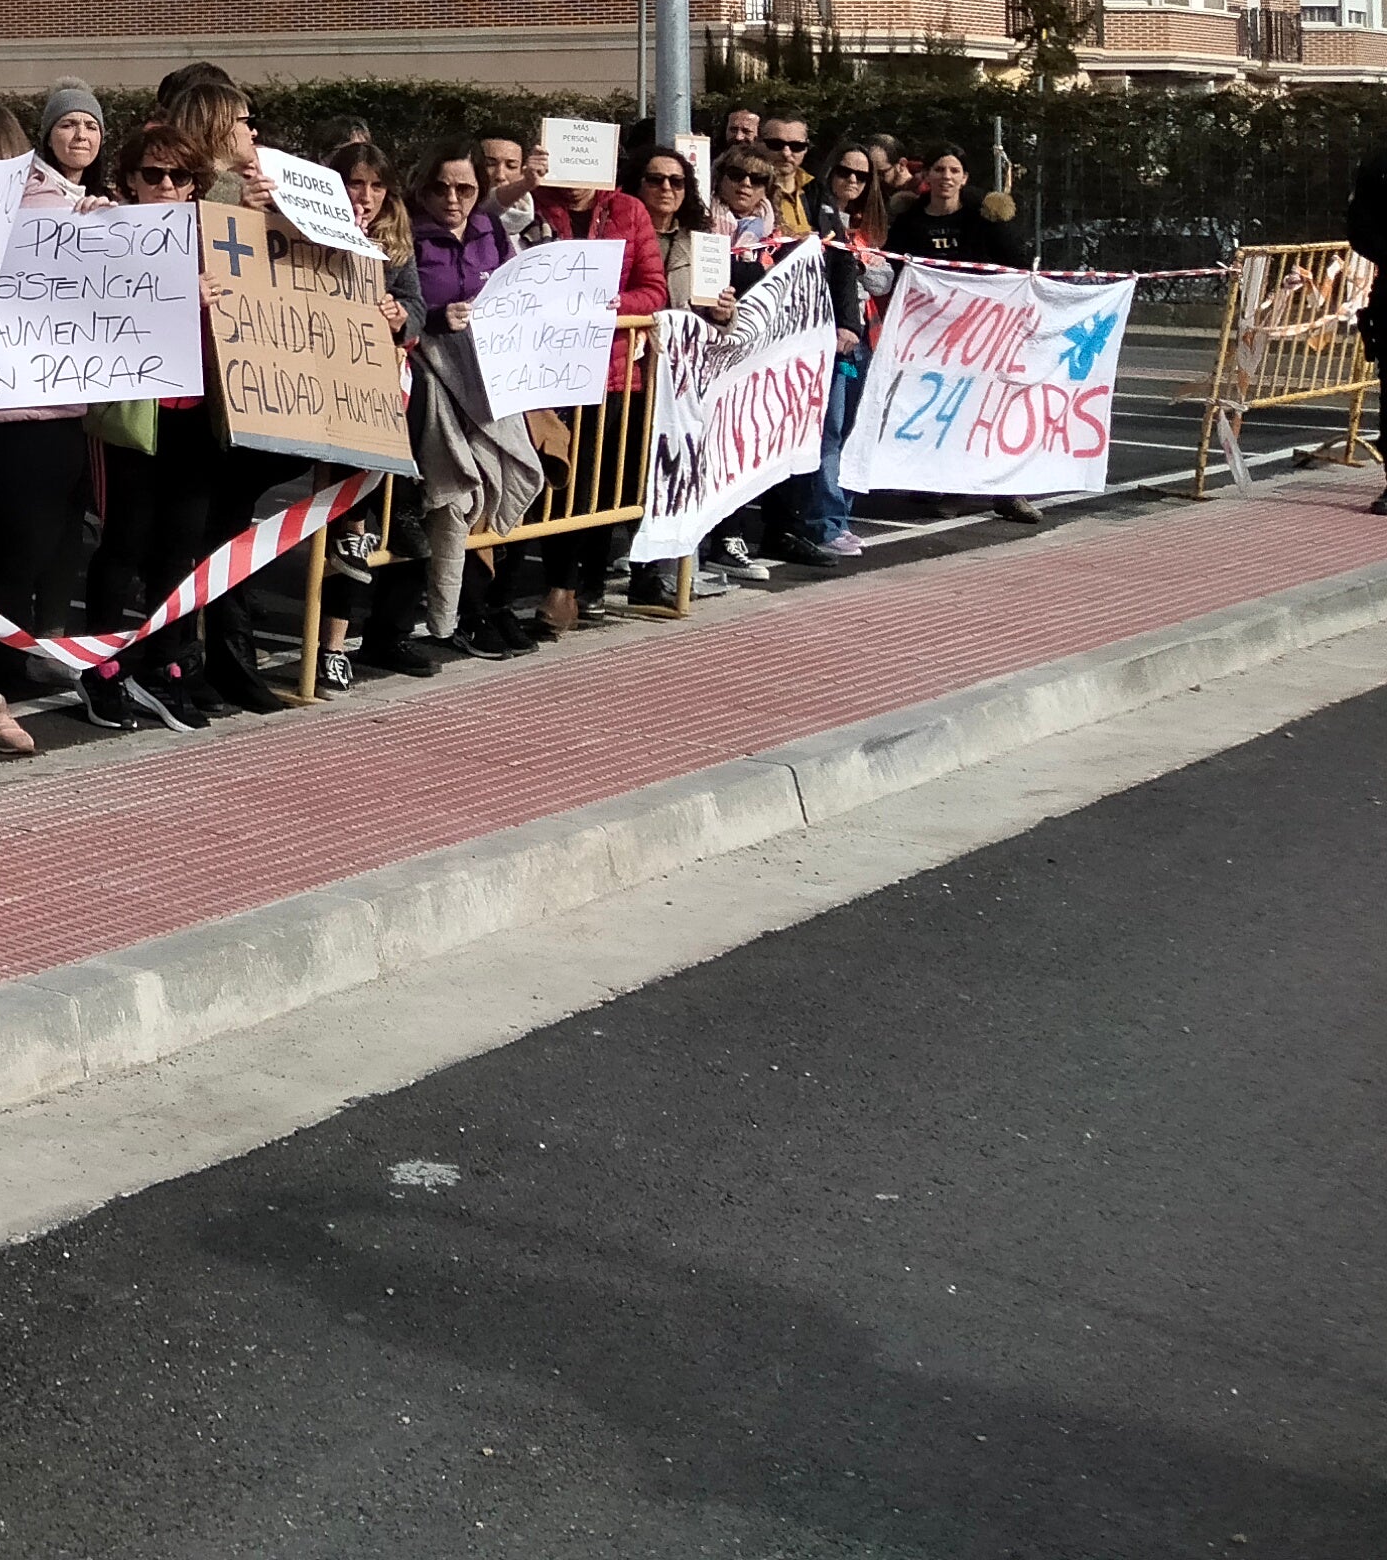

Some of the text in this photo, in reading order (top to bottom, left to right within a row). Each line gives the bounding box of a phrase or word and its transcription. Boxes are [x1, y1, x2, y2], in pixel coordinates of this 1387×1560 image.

[563, 134, 598, 143] PERSONAL
[571, 146, 590, 154] PARA
[559, 157, 600, 167] URGENCIAS
[282, 168, 334, 196] MEJORES
[278, 191, 351, 223] HOSPITALES
[499, 251, 599, 287] UESCA
[346, 317, 382, 367] DE
[533, 320, 614, 356] URGENTE
[30, 354, 184, 393] PARAR
[333, 379, 407, 434] HUMANA
[894, 371, 1110, 459] 24 HORAS
